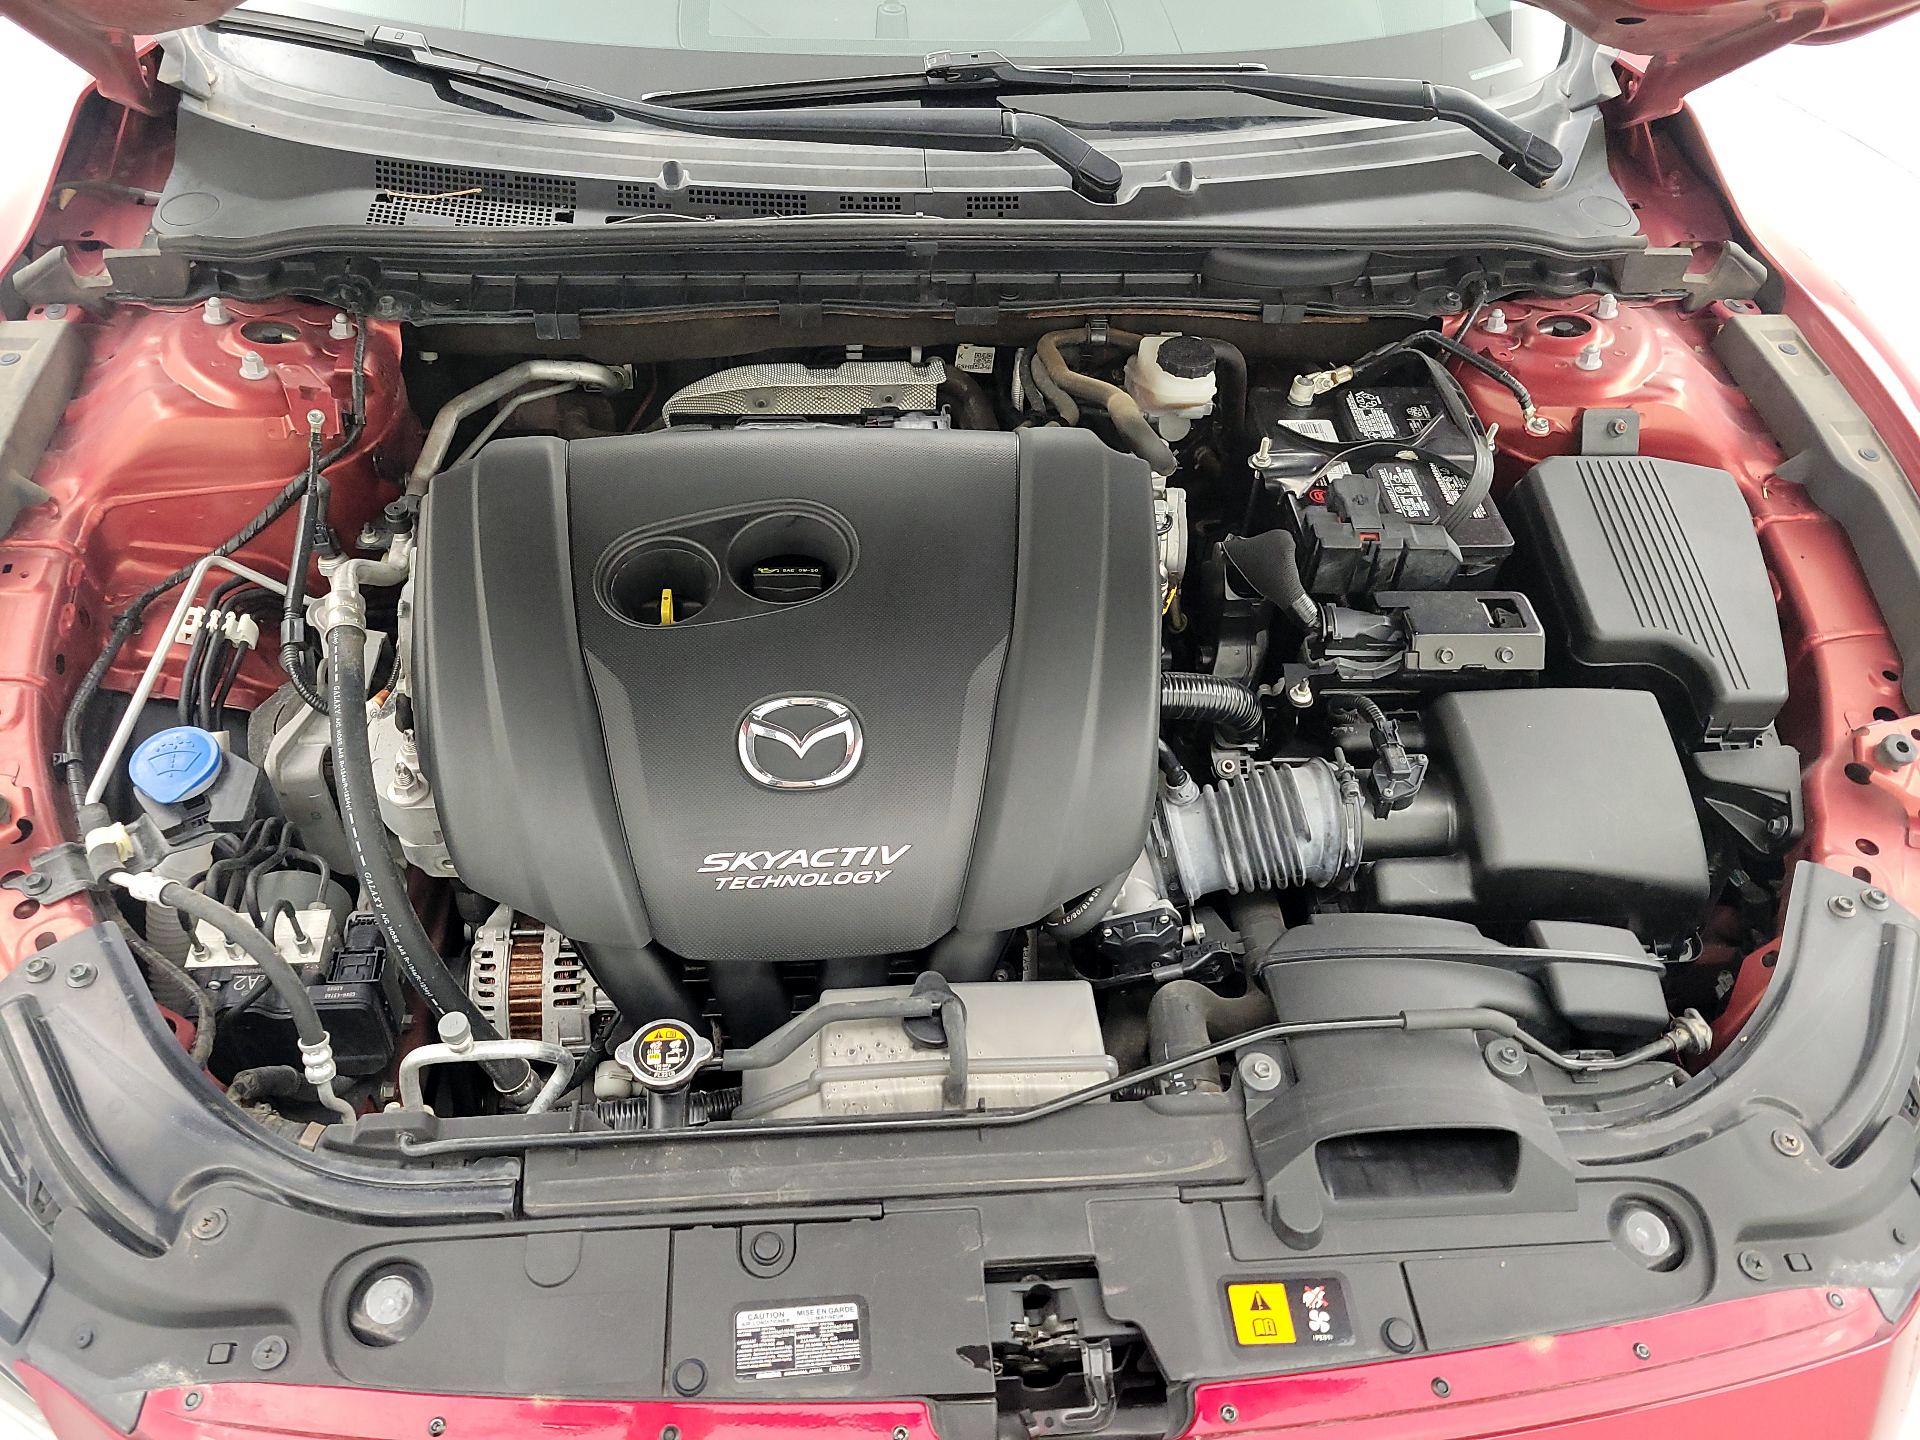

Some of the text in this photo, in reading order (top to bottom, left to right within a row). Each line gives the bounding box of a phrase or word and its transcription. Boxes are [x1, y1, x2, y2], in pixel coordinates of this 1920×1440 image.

[333, 685, 343, 714] GALAXY
[696, 844, 913, 873] SKYACTIV
[714, 869, 893, 891] TECHNOLOGY
[364, 871, 385, 910] GALAXY
[380, 913, 390, 925] A/C
[387, 926, 400, 944] HOSE
[747, 1311, 785, 1321] CAUTION
[796, 1309, 814, 1317] MISE
[828, 1306, 855, 1314] GARDE
